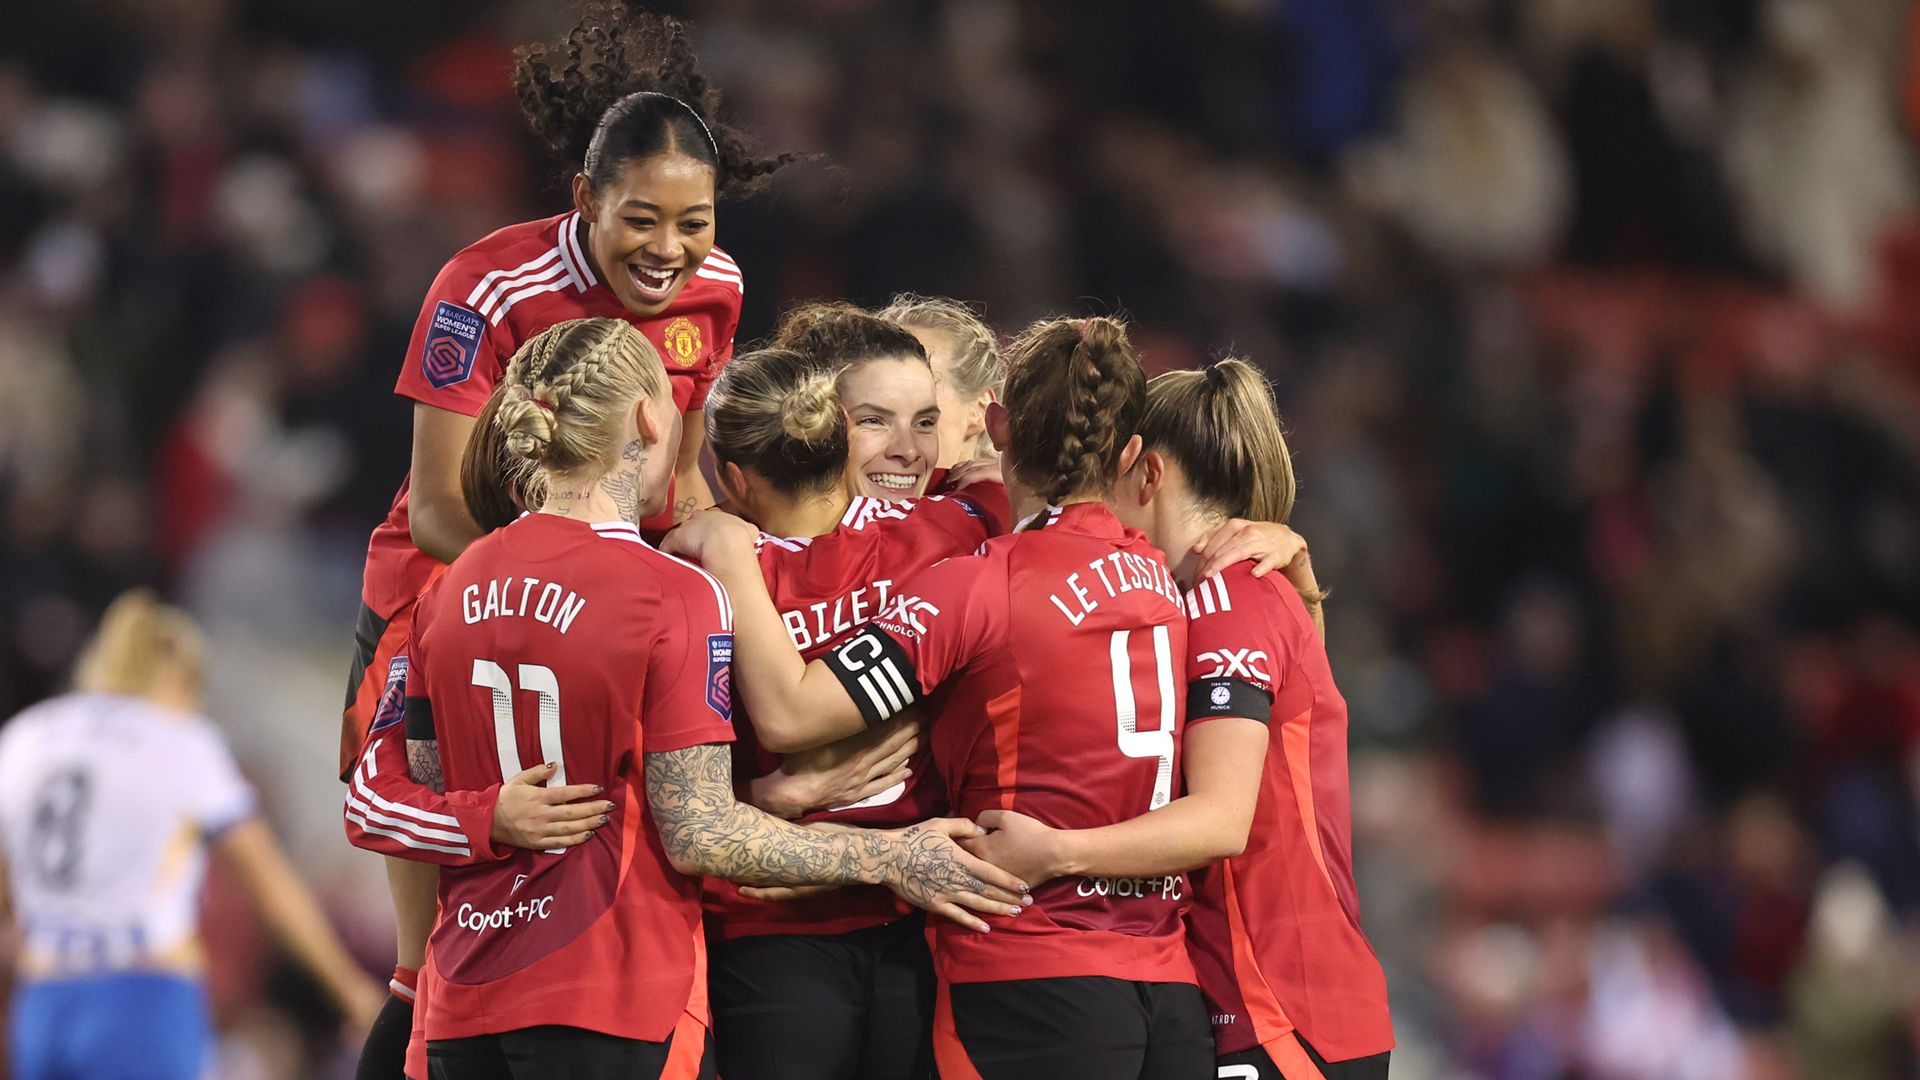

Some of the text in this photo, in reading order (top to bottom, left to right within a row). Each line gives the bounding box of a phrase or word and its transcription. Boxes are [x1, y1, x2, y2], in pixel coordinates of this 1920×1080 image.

[434, 323, 475, 340] SUPER LEAGUE
[436, 315, 477, 335] WOMEN'S
[445, 310, 480, 327] BARCLAYS
[675, 354, 697, 364] UNITED
[463, 577, 586, 634] GALTON
[1049, 572, 1098, 626] LE
[837, 633, 883, 672] C
[1196, 648, 1271, 681] DXC
[1110, 625, 1176, 811] 4
[472, 658, 567, 855] 11
